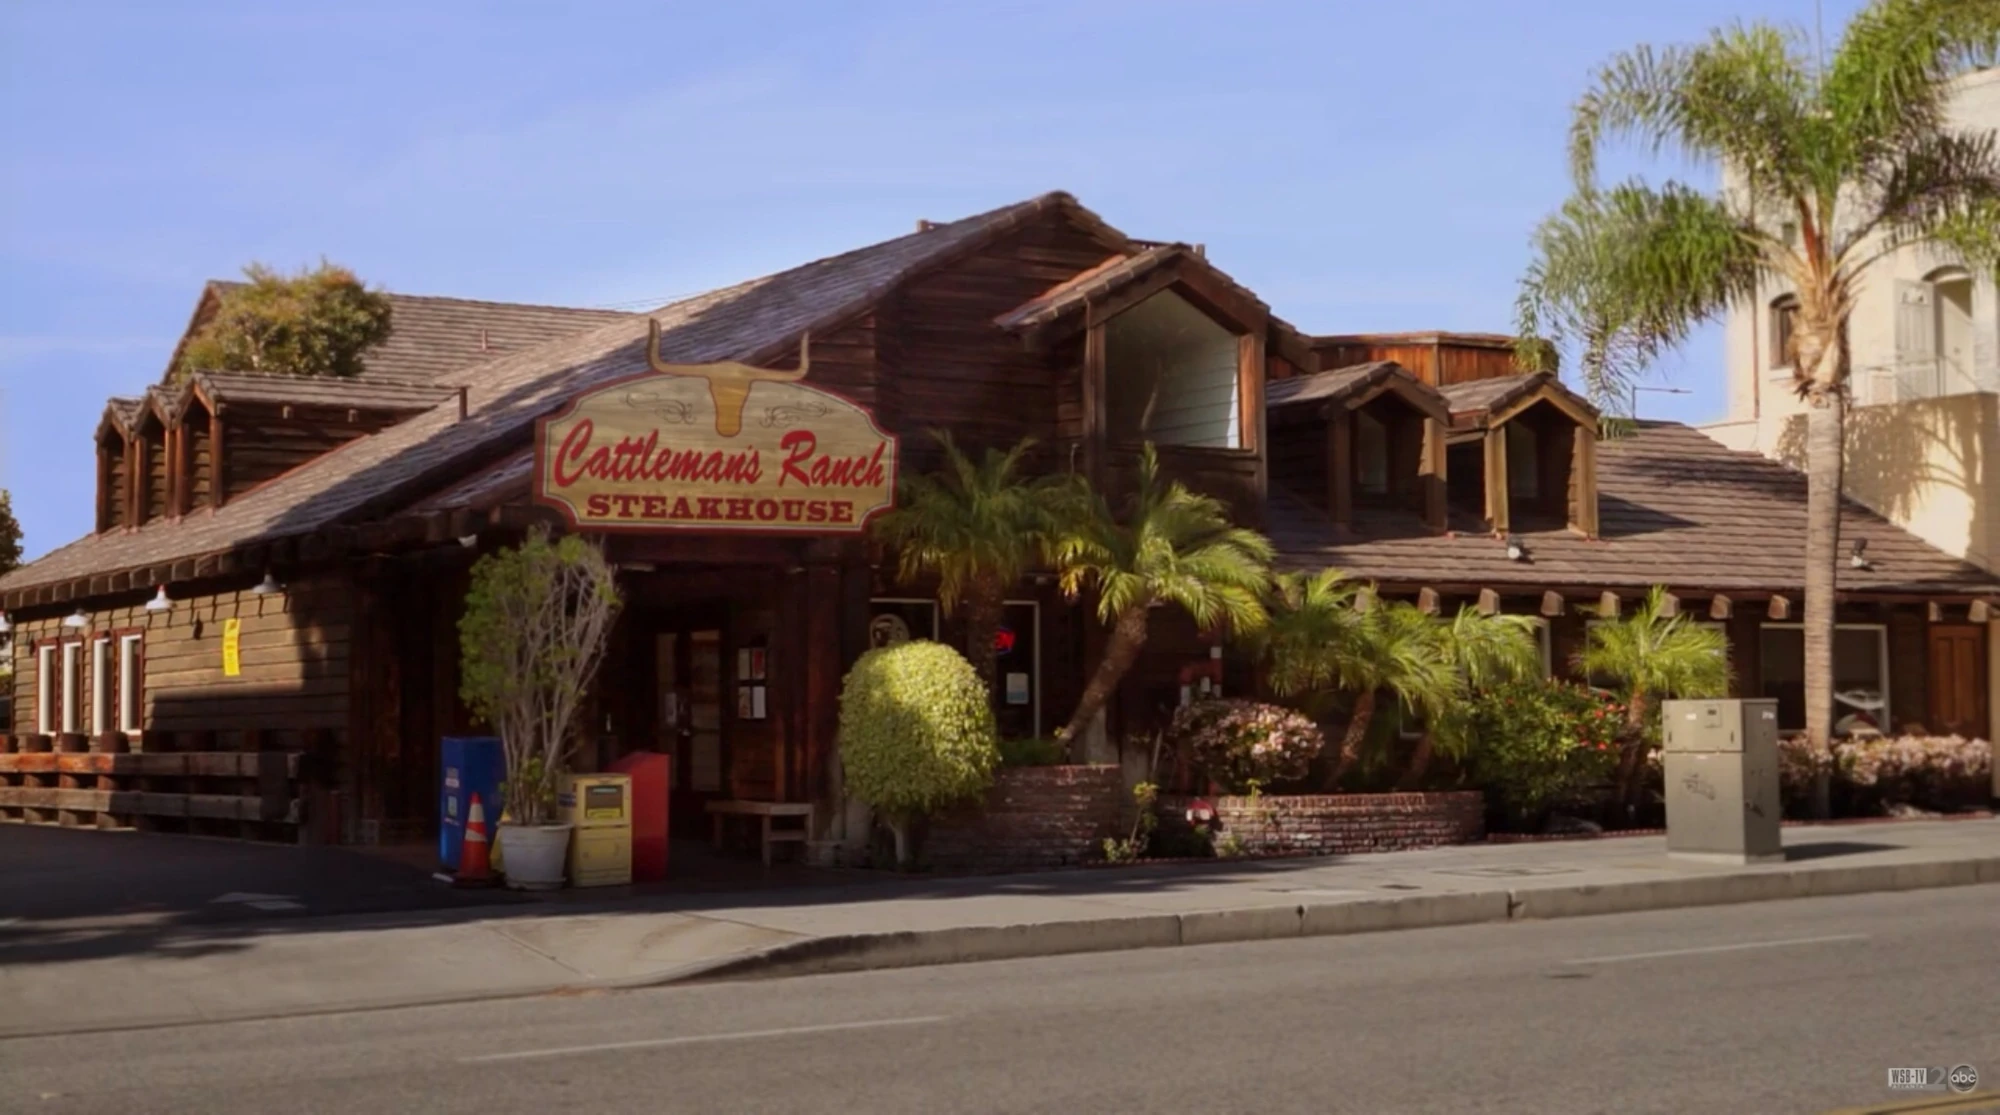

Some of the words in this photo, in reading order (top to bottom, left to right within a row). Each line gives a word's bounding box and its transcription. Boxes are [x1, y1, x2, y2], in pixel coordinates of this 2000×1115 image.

[554, 418, 763, 487] Cattleman's
[778, 430, 886, 488] Ranch
[587, 494, 853, 522] STEAKHOUSE
